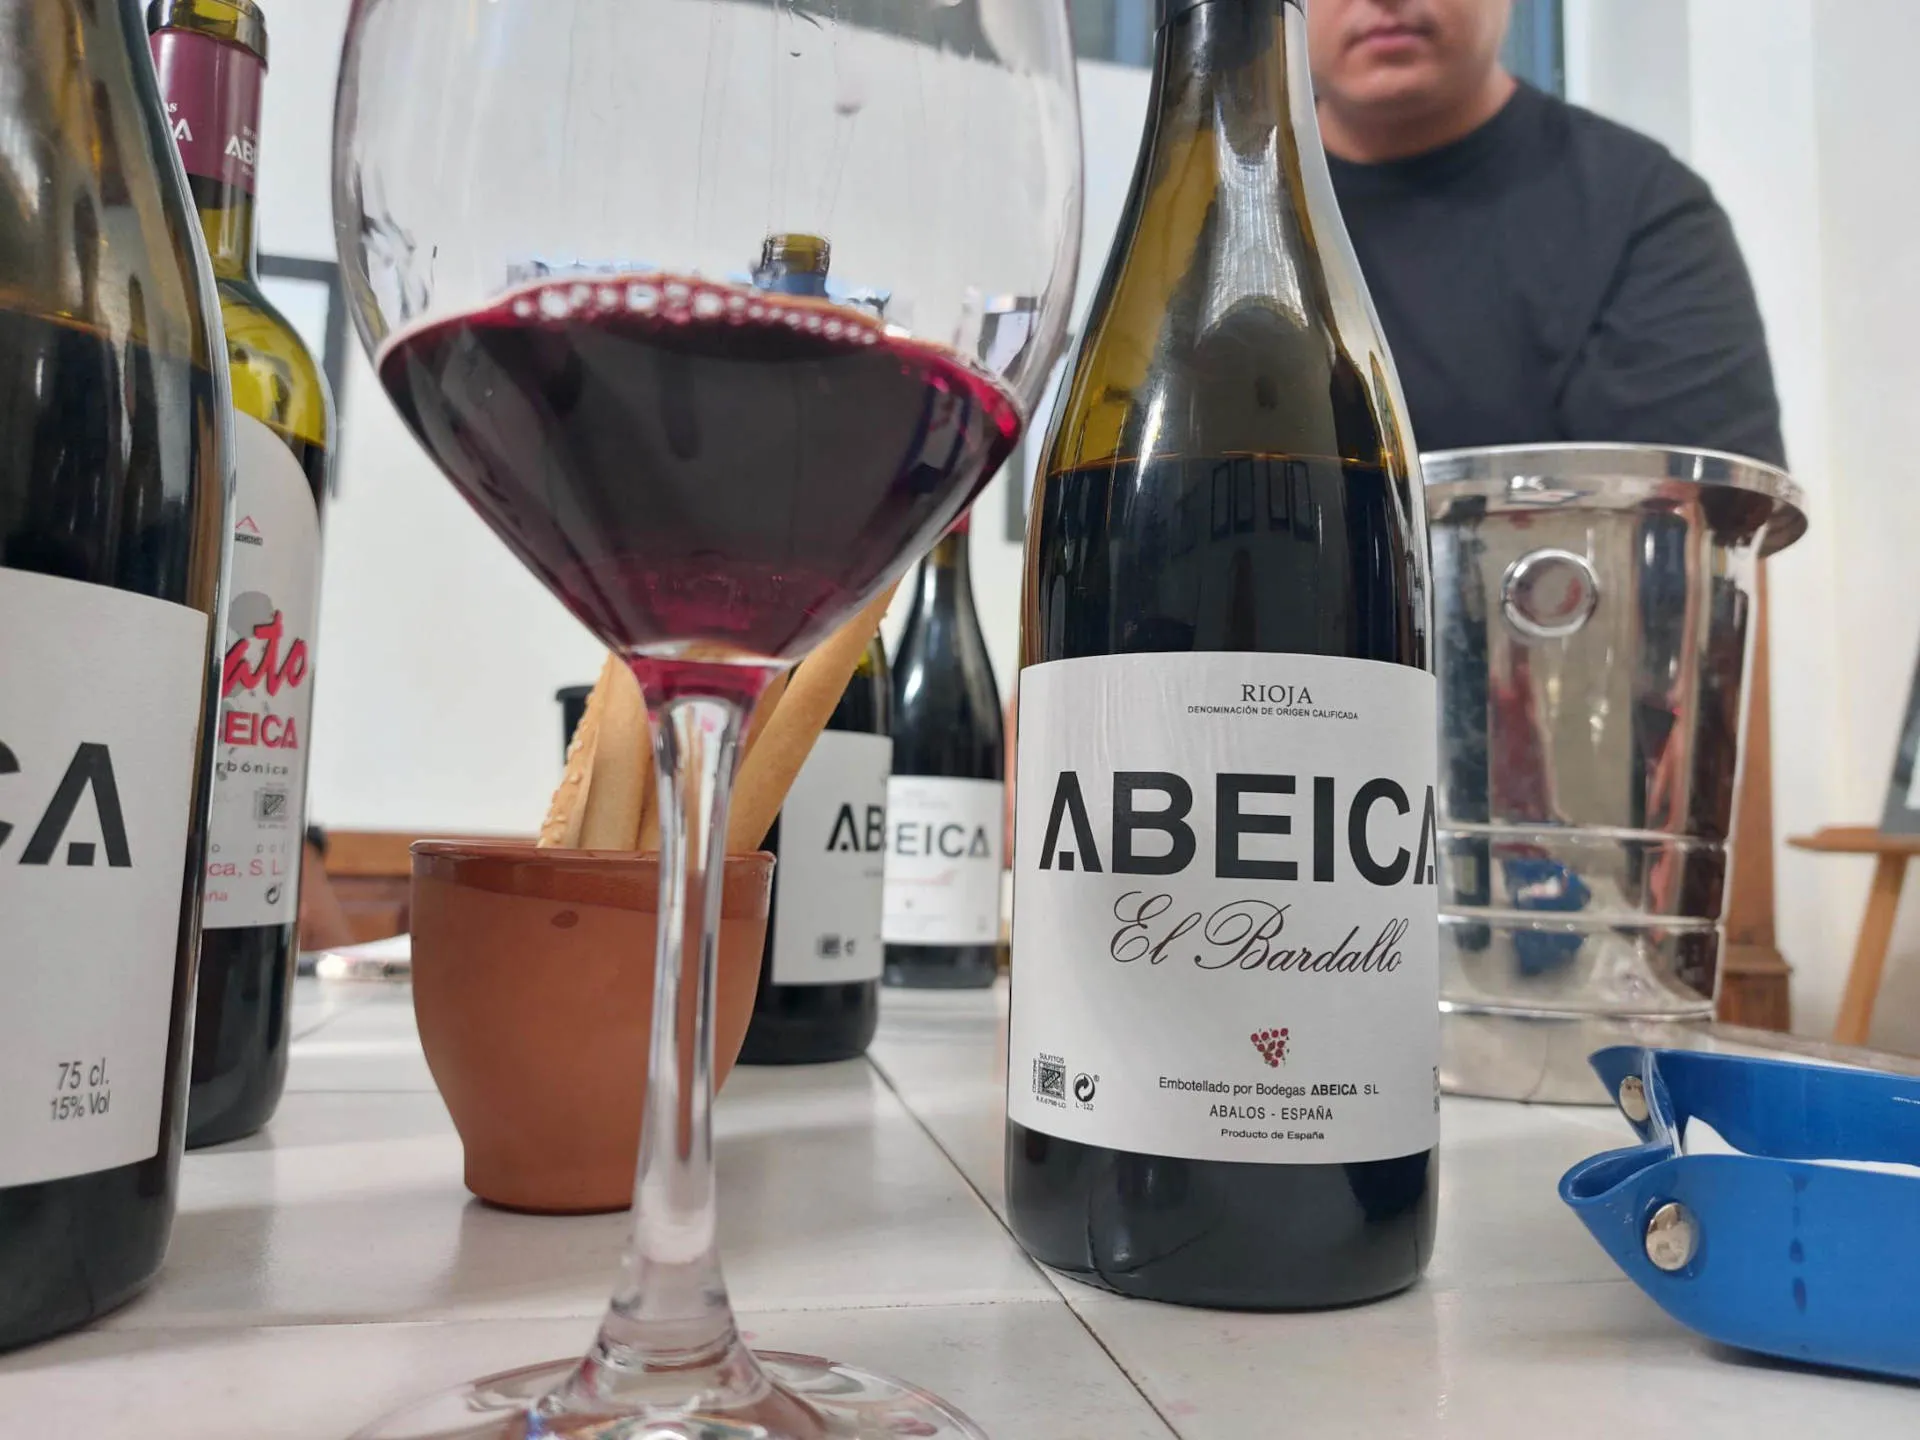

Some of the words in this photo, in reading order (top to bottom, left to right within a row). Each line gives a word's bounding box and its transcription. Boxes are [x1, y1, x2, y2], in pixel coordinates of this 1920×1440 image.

[1240, 684, 1312, 707] RIOJA
[1187, 704, 1258, 715] DENOMINACIÓN
[1261, 707, 1273, 716] DE
[1276, 707, 1310, 718] ORIGEN
[1312, 709, 1359, 720] CALIFICADA
[1039, 771, 1438, 886] ABEICA
[1110, 891, 1202, 965] El
[1194, 899, 1408, 972] Bardallo
[57, 1061, 82, 1091] 75
[89, 1057, 110, 1087] cl.
[1159, 1076, 1230, 1095] Embotellado
[1233, 1084, 1252, 1096] por
[1256, 1083, 1306, 1099] Bodegas
[1310, 1083, 1357, 1096] ABEICA
[50, 1095, 85, 1121] 15%
[89, 1089, 111, 1115] Vol
[1209, 1104, 1266, 1120] ABALOS
[1281, 1105, 1333, 1121] ESPAÑA
[1221, 1128, 1268, 1139] Producto
[1270, 1131, 1284, 1140] de
[1287, 1131, 1325, 1141] España
